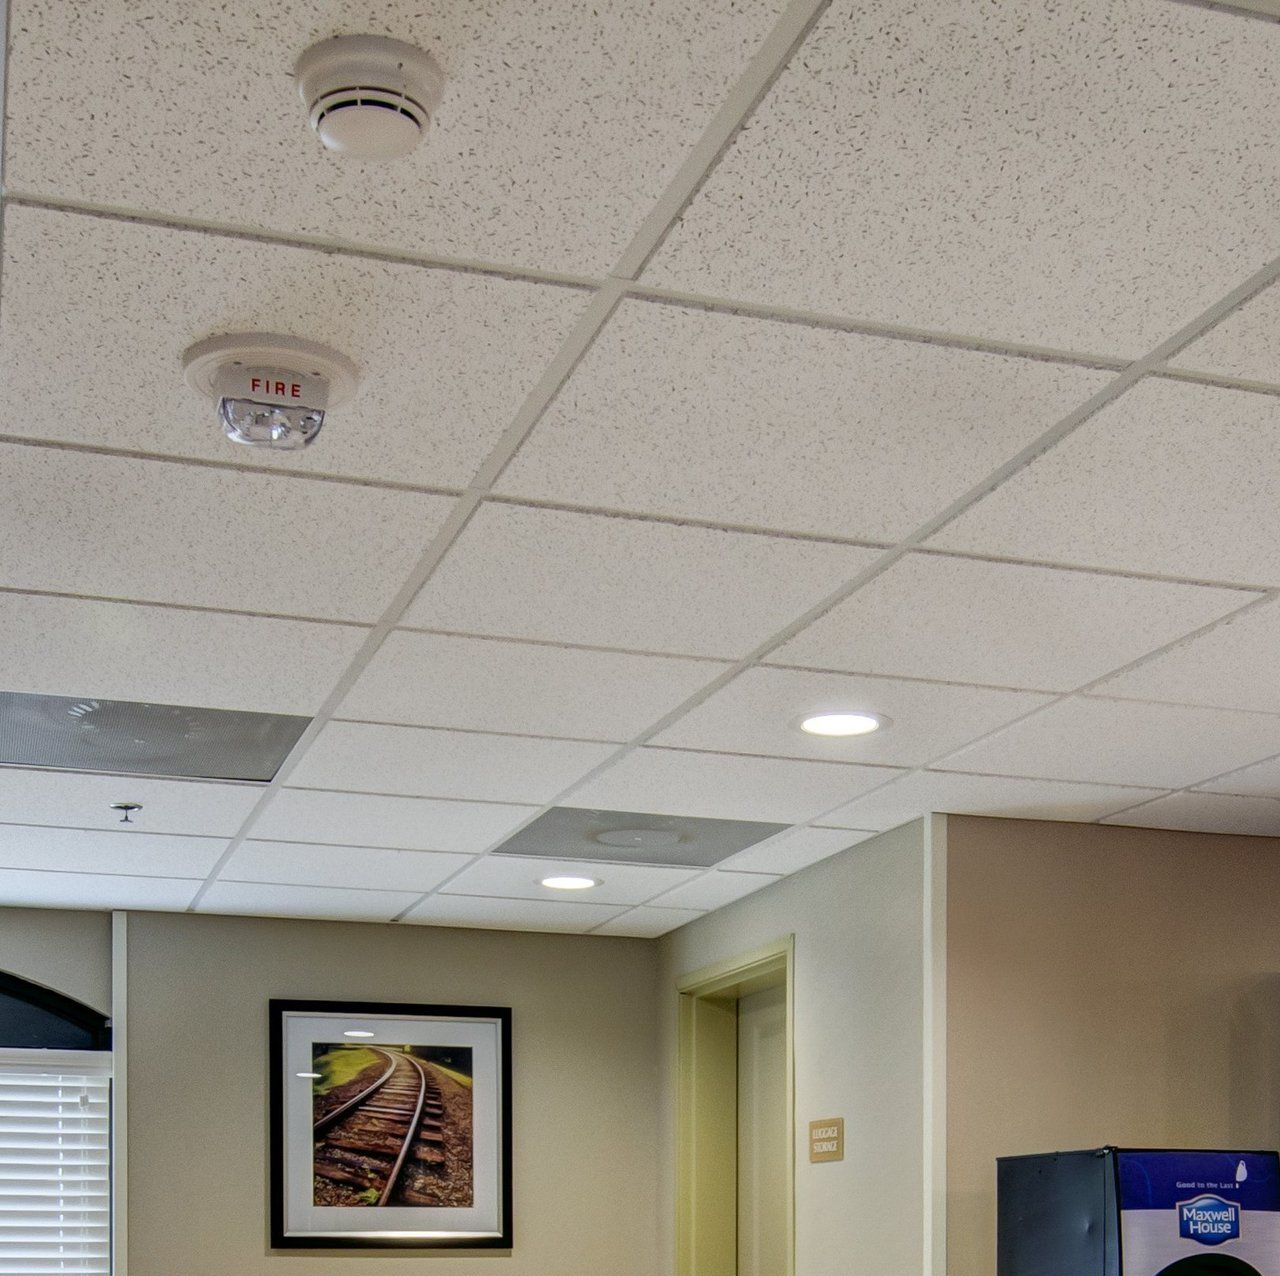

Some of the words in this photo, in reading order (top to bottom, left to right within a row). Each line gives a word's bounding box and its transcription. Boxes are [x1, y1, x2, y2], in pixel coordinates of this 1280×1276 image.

[250, 378, 302, 398] FIRE
[1176, 1181, 1195, 1189] Good
[1182, 1207, 1235, 1222] Maxwell
[1189, 1221, 1232, 1234] House
